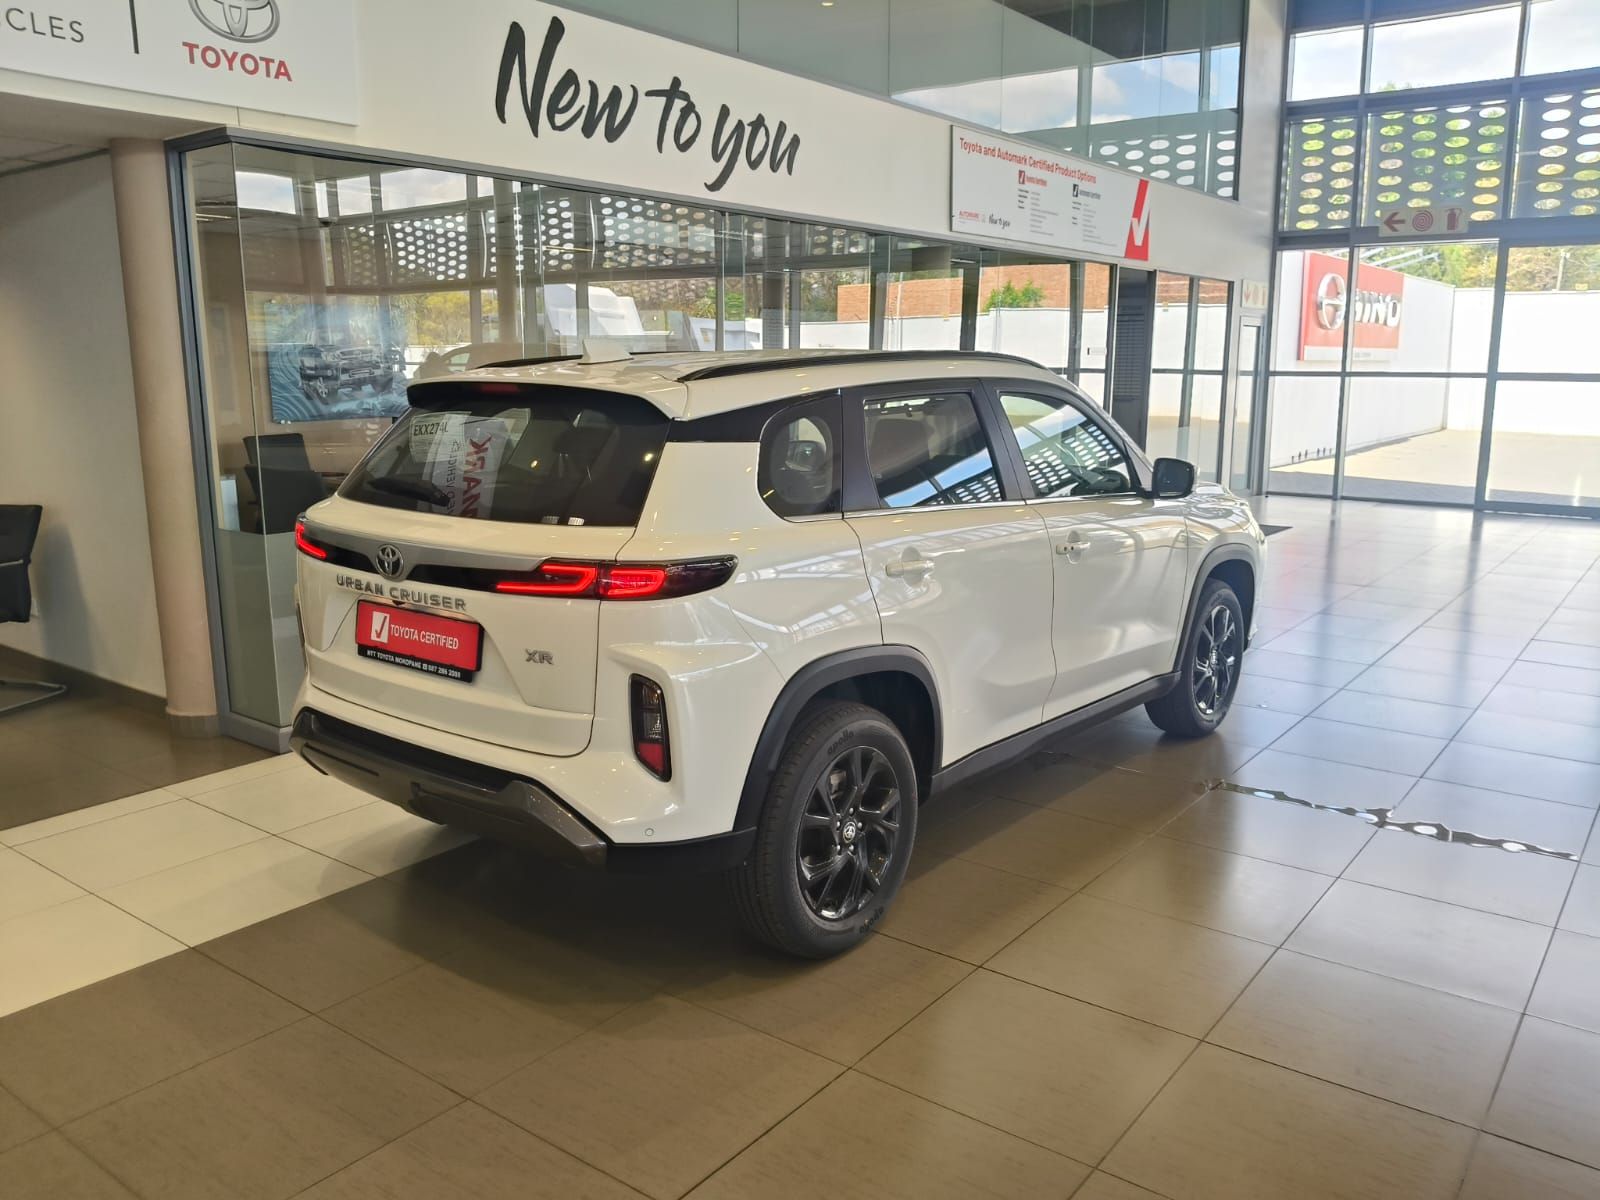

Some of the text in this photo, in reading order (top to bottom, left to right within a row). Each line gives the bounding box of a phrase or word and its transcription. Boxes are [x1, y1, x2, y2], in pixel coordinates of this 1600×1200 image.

[182, 41, 293, 82] TOYOTA
[495, 16, 800, 192] New to you
[960, 138, 1096, 184] Toyota and Automark Certified Product Options
[336, 574, 467, 611] URBAN CRUISER
[390, 624, 459, 650] TOYOTA CERTIFIED
[377, 652, 394, 662] TOYOTA
[525, 648, 554, 665] XR
[827, 727, 855, 755] apollo
